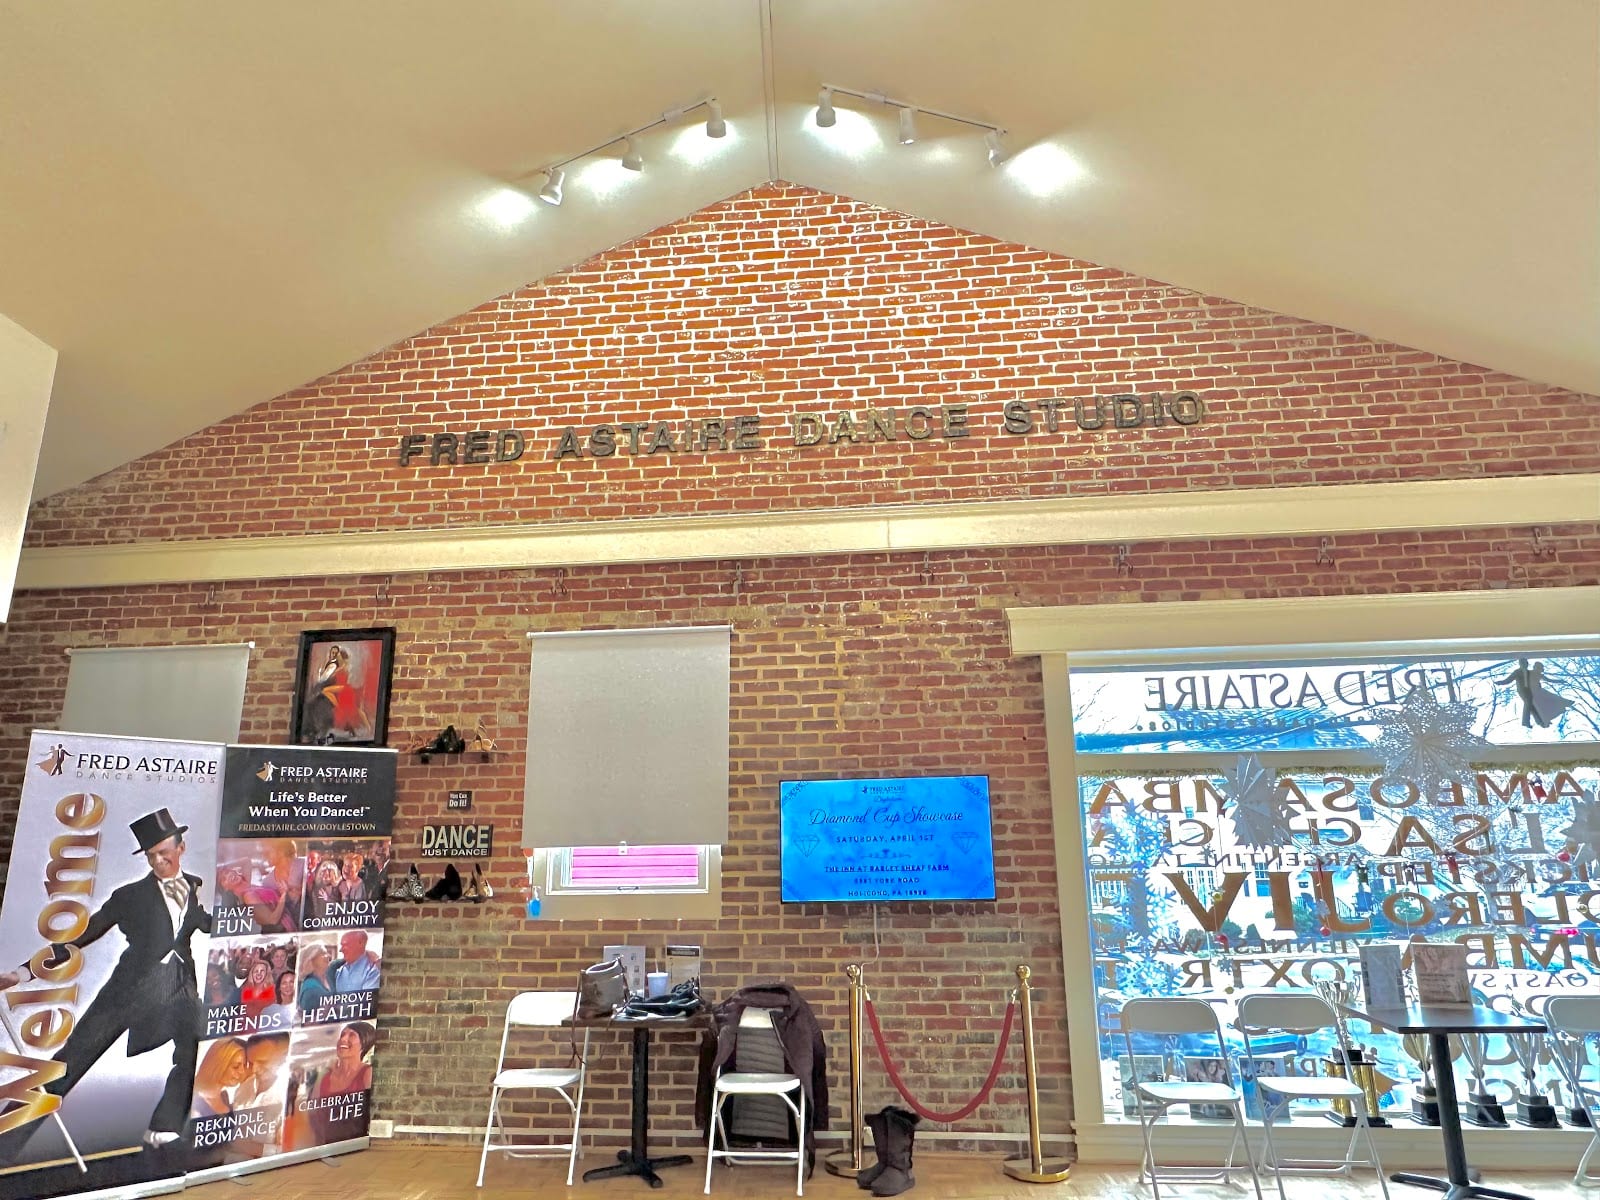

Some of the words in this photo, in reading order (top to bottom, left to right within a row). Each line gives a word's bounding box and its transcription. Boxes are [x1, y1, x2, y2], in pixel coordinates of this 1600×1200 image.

[400, 429, 526, 467] FRED
[553, 415, 760, 459] ASTAIRE
[793, 403, 970, 447] DANCE
[1003, 389, 1204, 434] STUDIO
[76, 753, 131, 771] FRED
[135, 756, 218, 775] ASTAIRE
[280, 766, 313, 777] FRED
[316, 767, 368, 778] ASTAIRE
[76, 771, 133, 781] DANCE
[145, 773, 217, 784] STUDIOS
[269, 791, 305, 803] Life's
[308, 792, 348, 803] Better
[248, 806, 289, 817] When
[292, 806, 318, 817] You
[808, 807, 872, 826] Diamond
[873, 806, 900, 829] Cup
[903, 806, 964, 824] Showcase
[238, 823, 377, 832] FREDASTAIRE.COM/DOYLESTOWN
[422, 825, 490, 849] DANCE
[450, 848, 488, 856] DANCE
[217, 906, 254, 919] HAVE
[325, 900, 380, 916] ENJOY
[216, 918, 254, 935] FUN
[303, 915, 379, 929] COMMUNITY
[0, 791, 107, 1137] Welcome
[319, 991, 373, 1006] IMPROVE
[207, 1004, 248, 1019] MAKE
[301, 1003, 372, 1024] HEALTH
[206, 1013, 282, 1035] FRIENDS
[298, 1091, 364, 1112] CELEBRATE
[329, 1103, 364, 1122] LIFE
[195, 1111, 265, 1133] REKINDLE
[194, 1121, 277, 1148] ROMANCE
